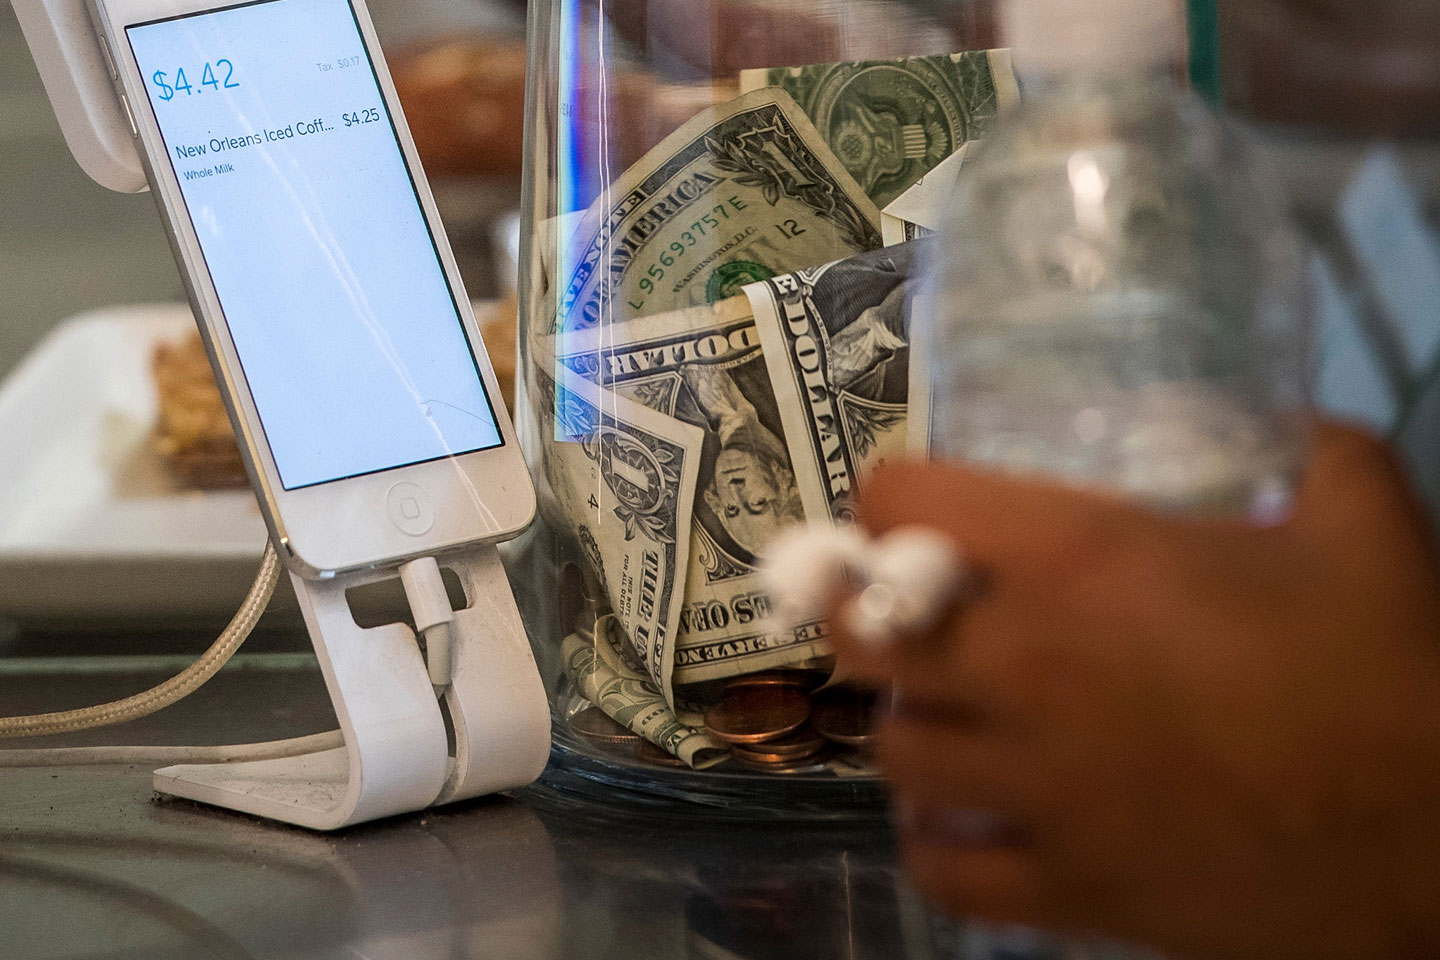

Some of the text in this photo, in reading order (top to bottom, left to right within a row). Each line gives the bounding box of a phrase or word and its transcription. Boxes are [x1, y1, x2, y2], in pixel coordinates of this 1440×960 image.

[152, 58, 240, 102] $4.42
[316, 55, 361, 73] Tax $0.17
[175, 107, 381, 160] New Orleans Iced Coff... $4.25
[183, 162, 236, 181] Whole Milk
[607, 171, 721, 287] AMERICA
[773, 219, 807, 240] 12
[605, 324, 760, 376] DOLLAR
[782, 297, 851, 498] DOLLAR
[637, 548, 660, 622] THE
[707, 625, 817, 658] ESERVE
